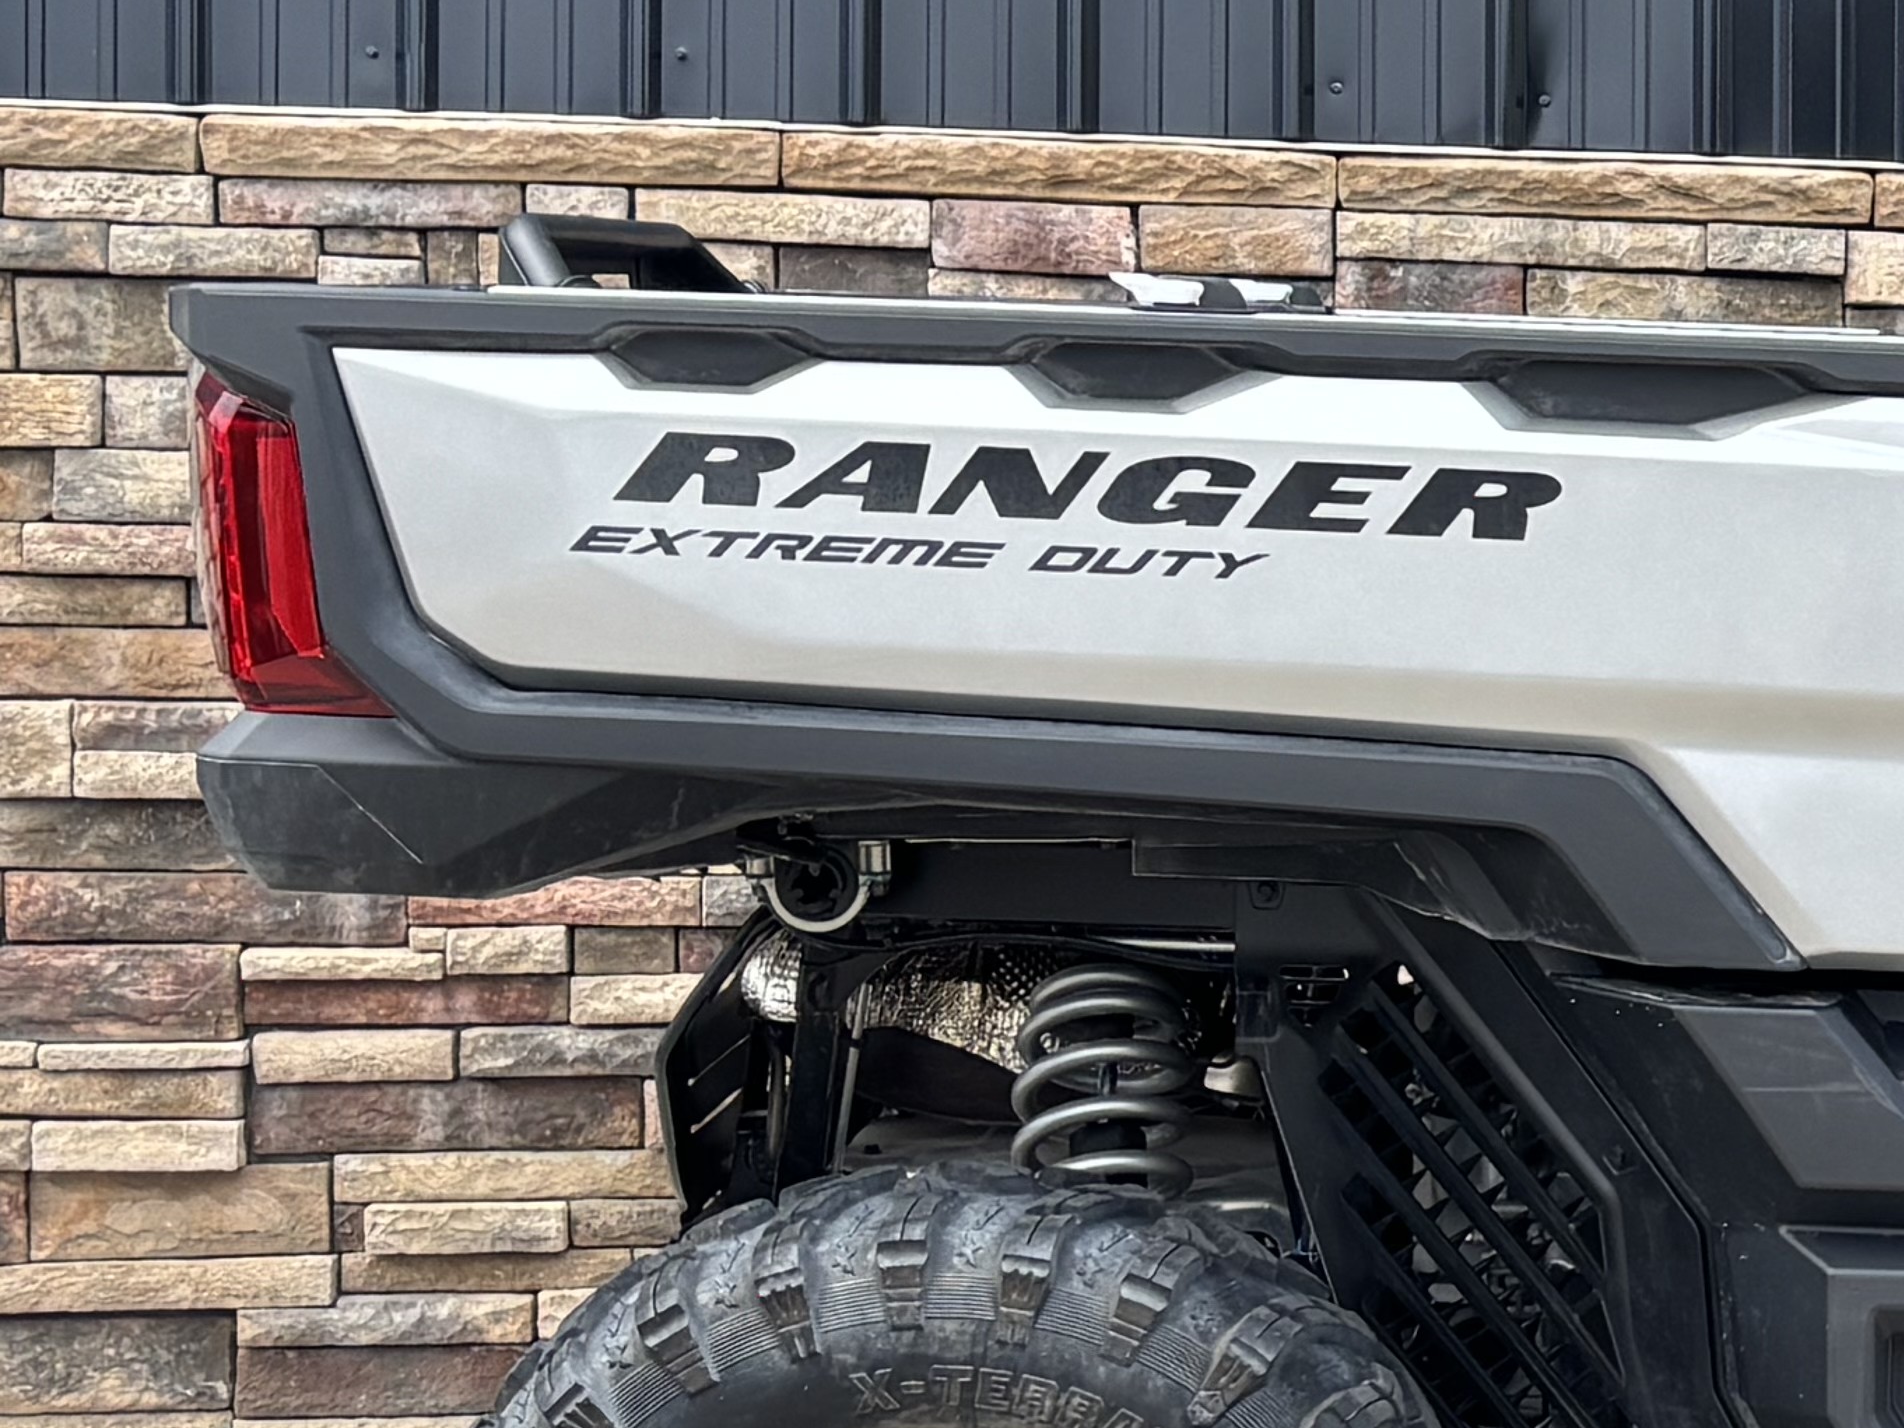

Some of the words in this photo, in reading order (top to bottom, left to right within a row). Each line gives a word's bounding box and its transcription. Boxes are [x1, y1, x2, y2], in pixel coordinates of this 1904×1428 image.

[611, 430, 1563, 542] RANGER
[568, 523, 1006, 571] EXTREME
[1027, 542, 1271, 579] DUTY
